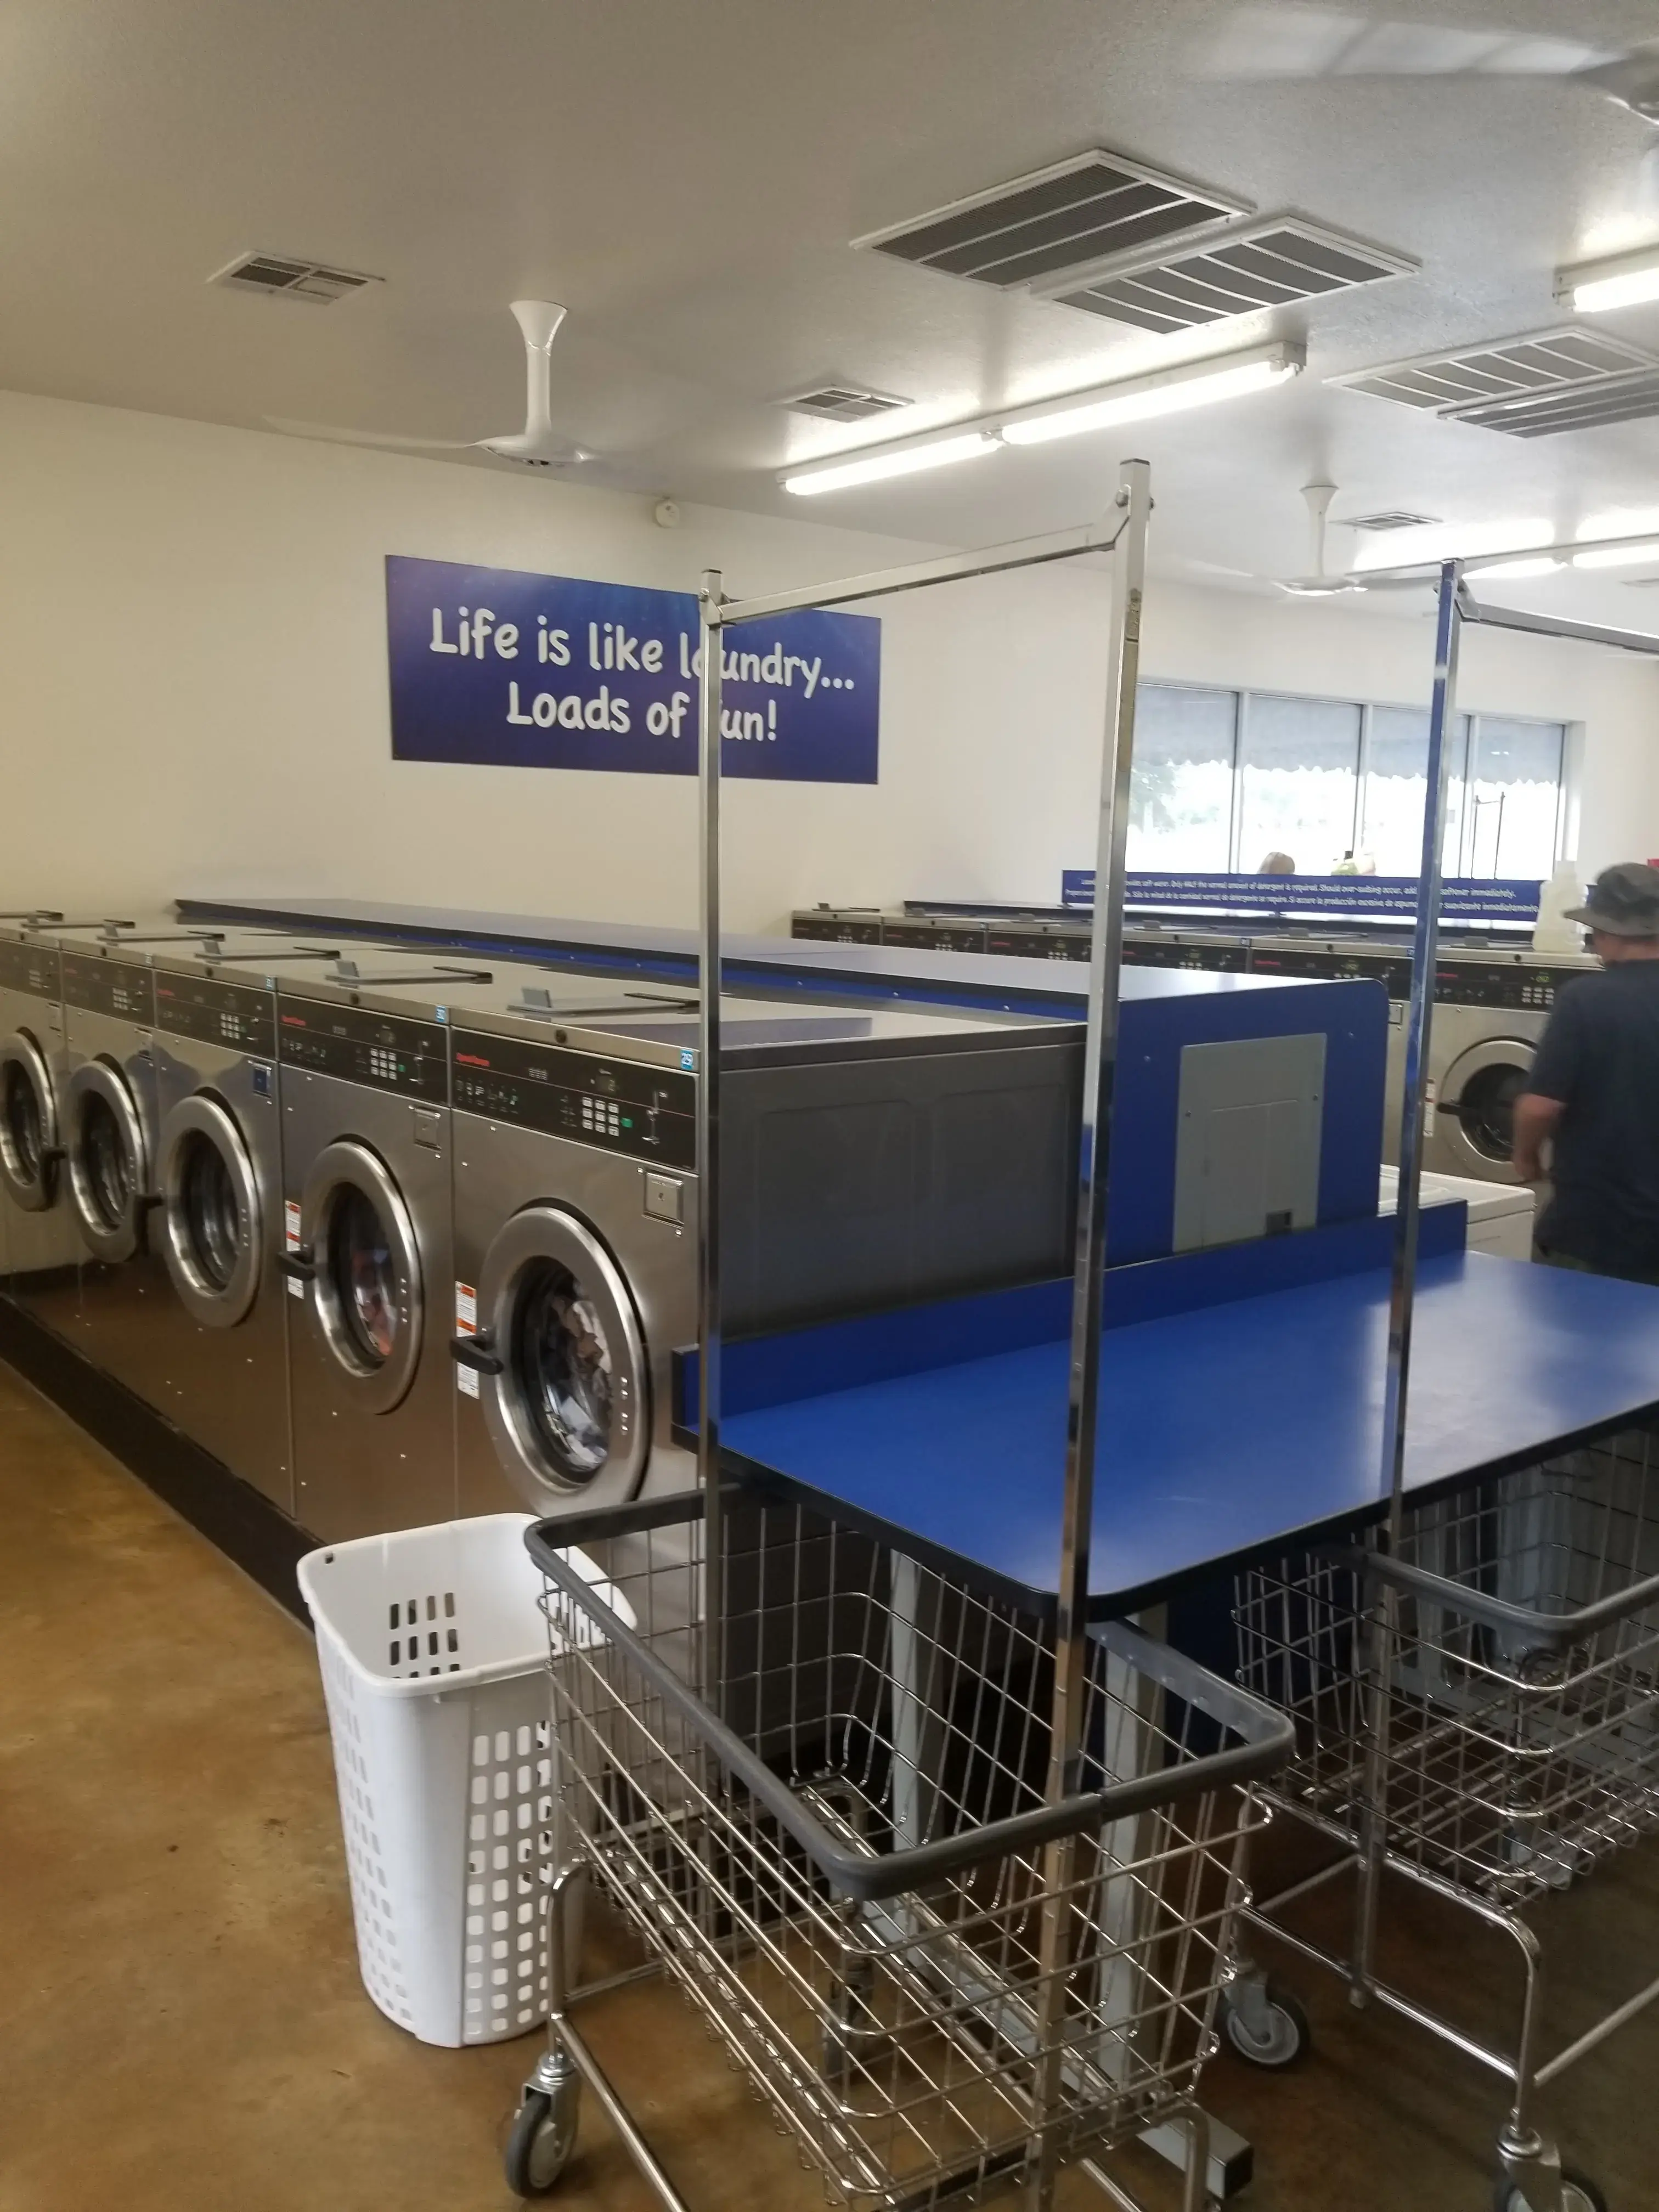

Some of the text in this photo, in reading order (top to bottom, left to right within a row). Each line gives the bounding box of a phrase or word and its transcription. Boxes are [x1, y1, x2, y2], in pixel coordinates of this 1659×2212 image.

[430, 606, 518, 659] Life
[537, 614, 571, 667] is
[589, 622, 663, 673] like
[506, 681, 777, 741] Loads of un!
